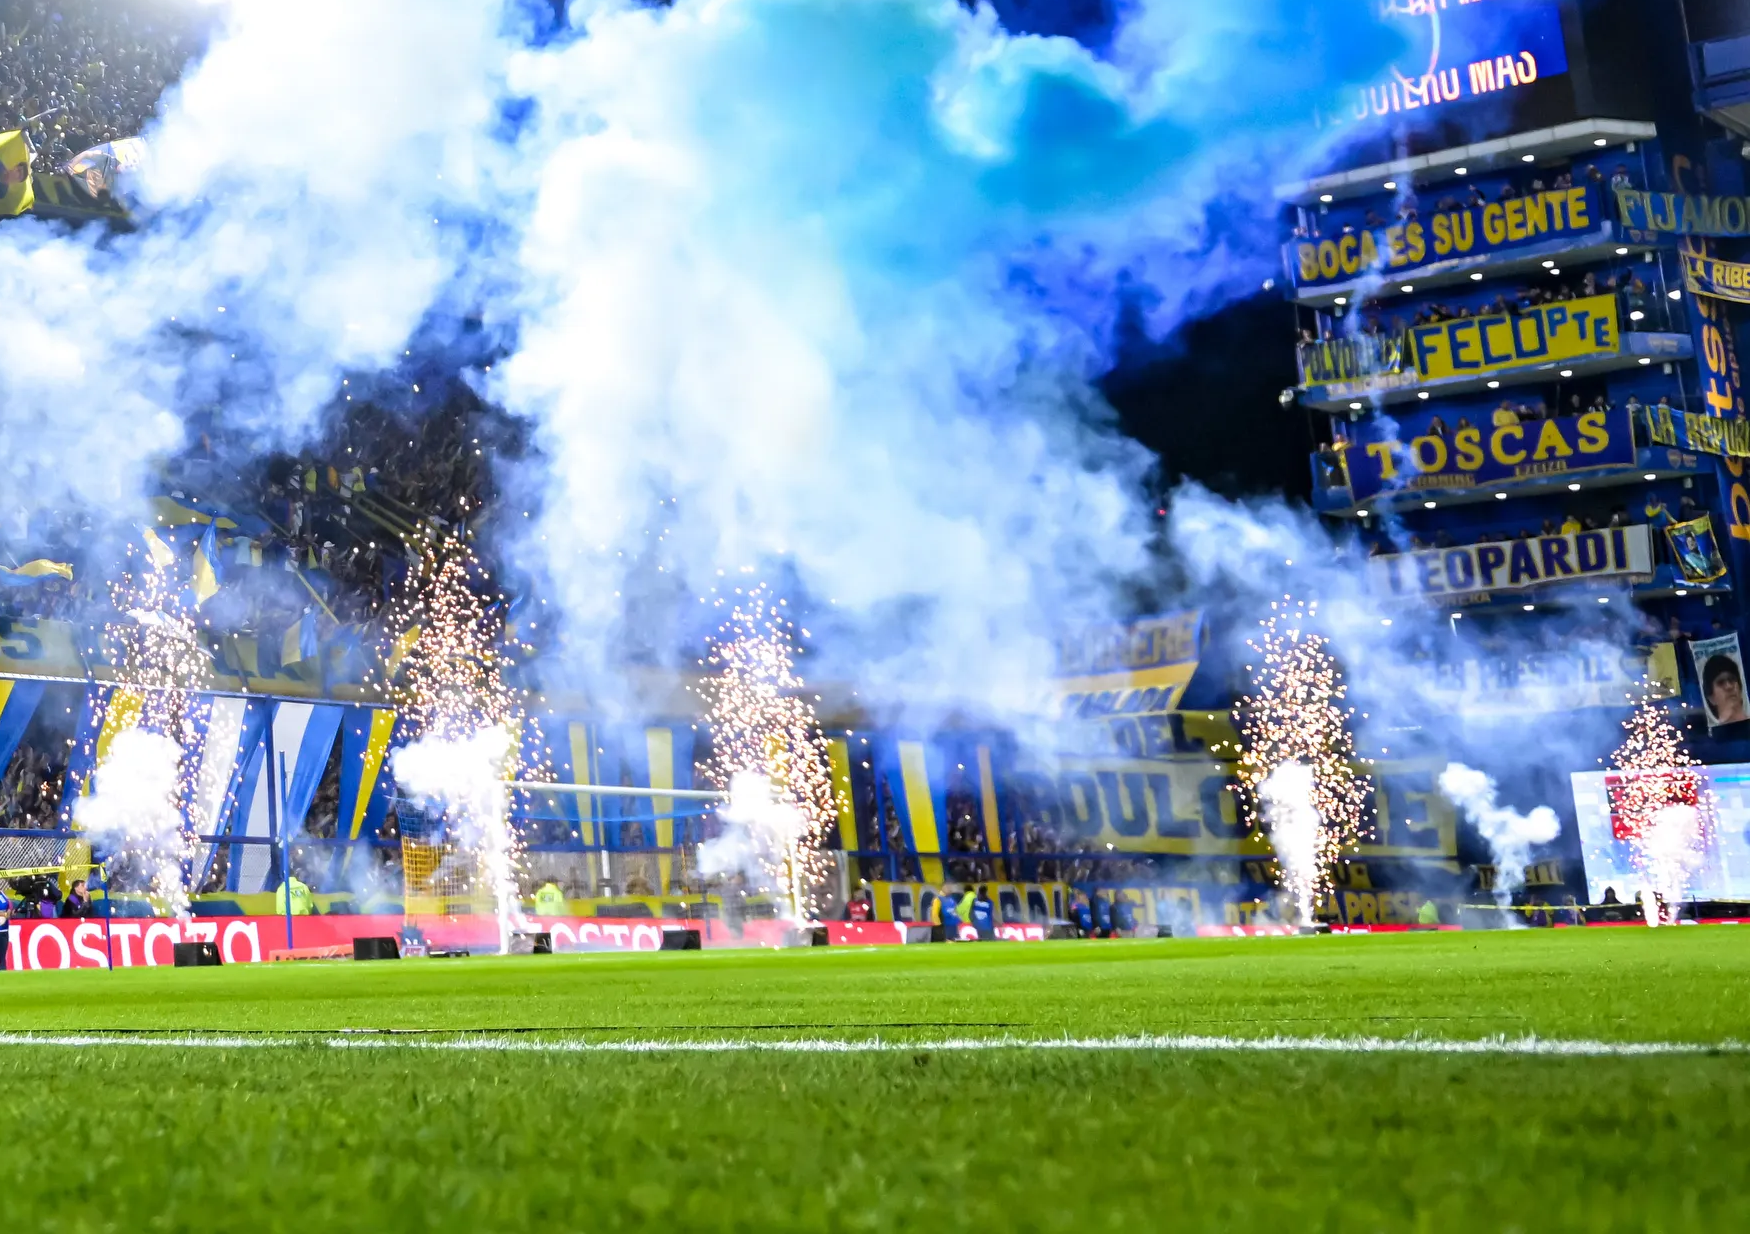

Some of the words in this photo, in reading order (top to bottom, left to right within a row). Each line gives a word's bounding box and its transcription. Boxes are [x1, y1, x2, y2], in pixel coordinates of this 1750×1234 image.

[1386, 221, 1426, 267] ES
[1432, 210, 1475, 255] SU
[1482, 187, 1590, 245] GENTE
[1365, 411, 1610, 480] TOSCAS
